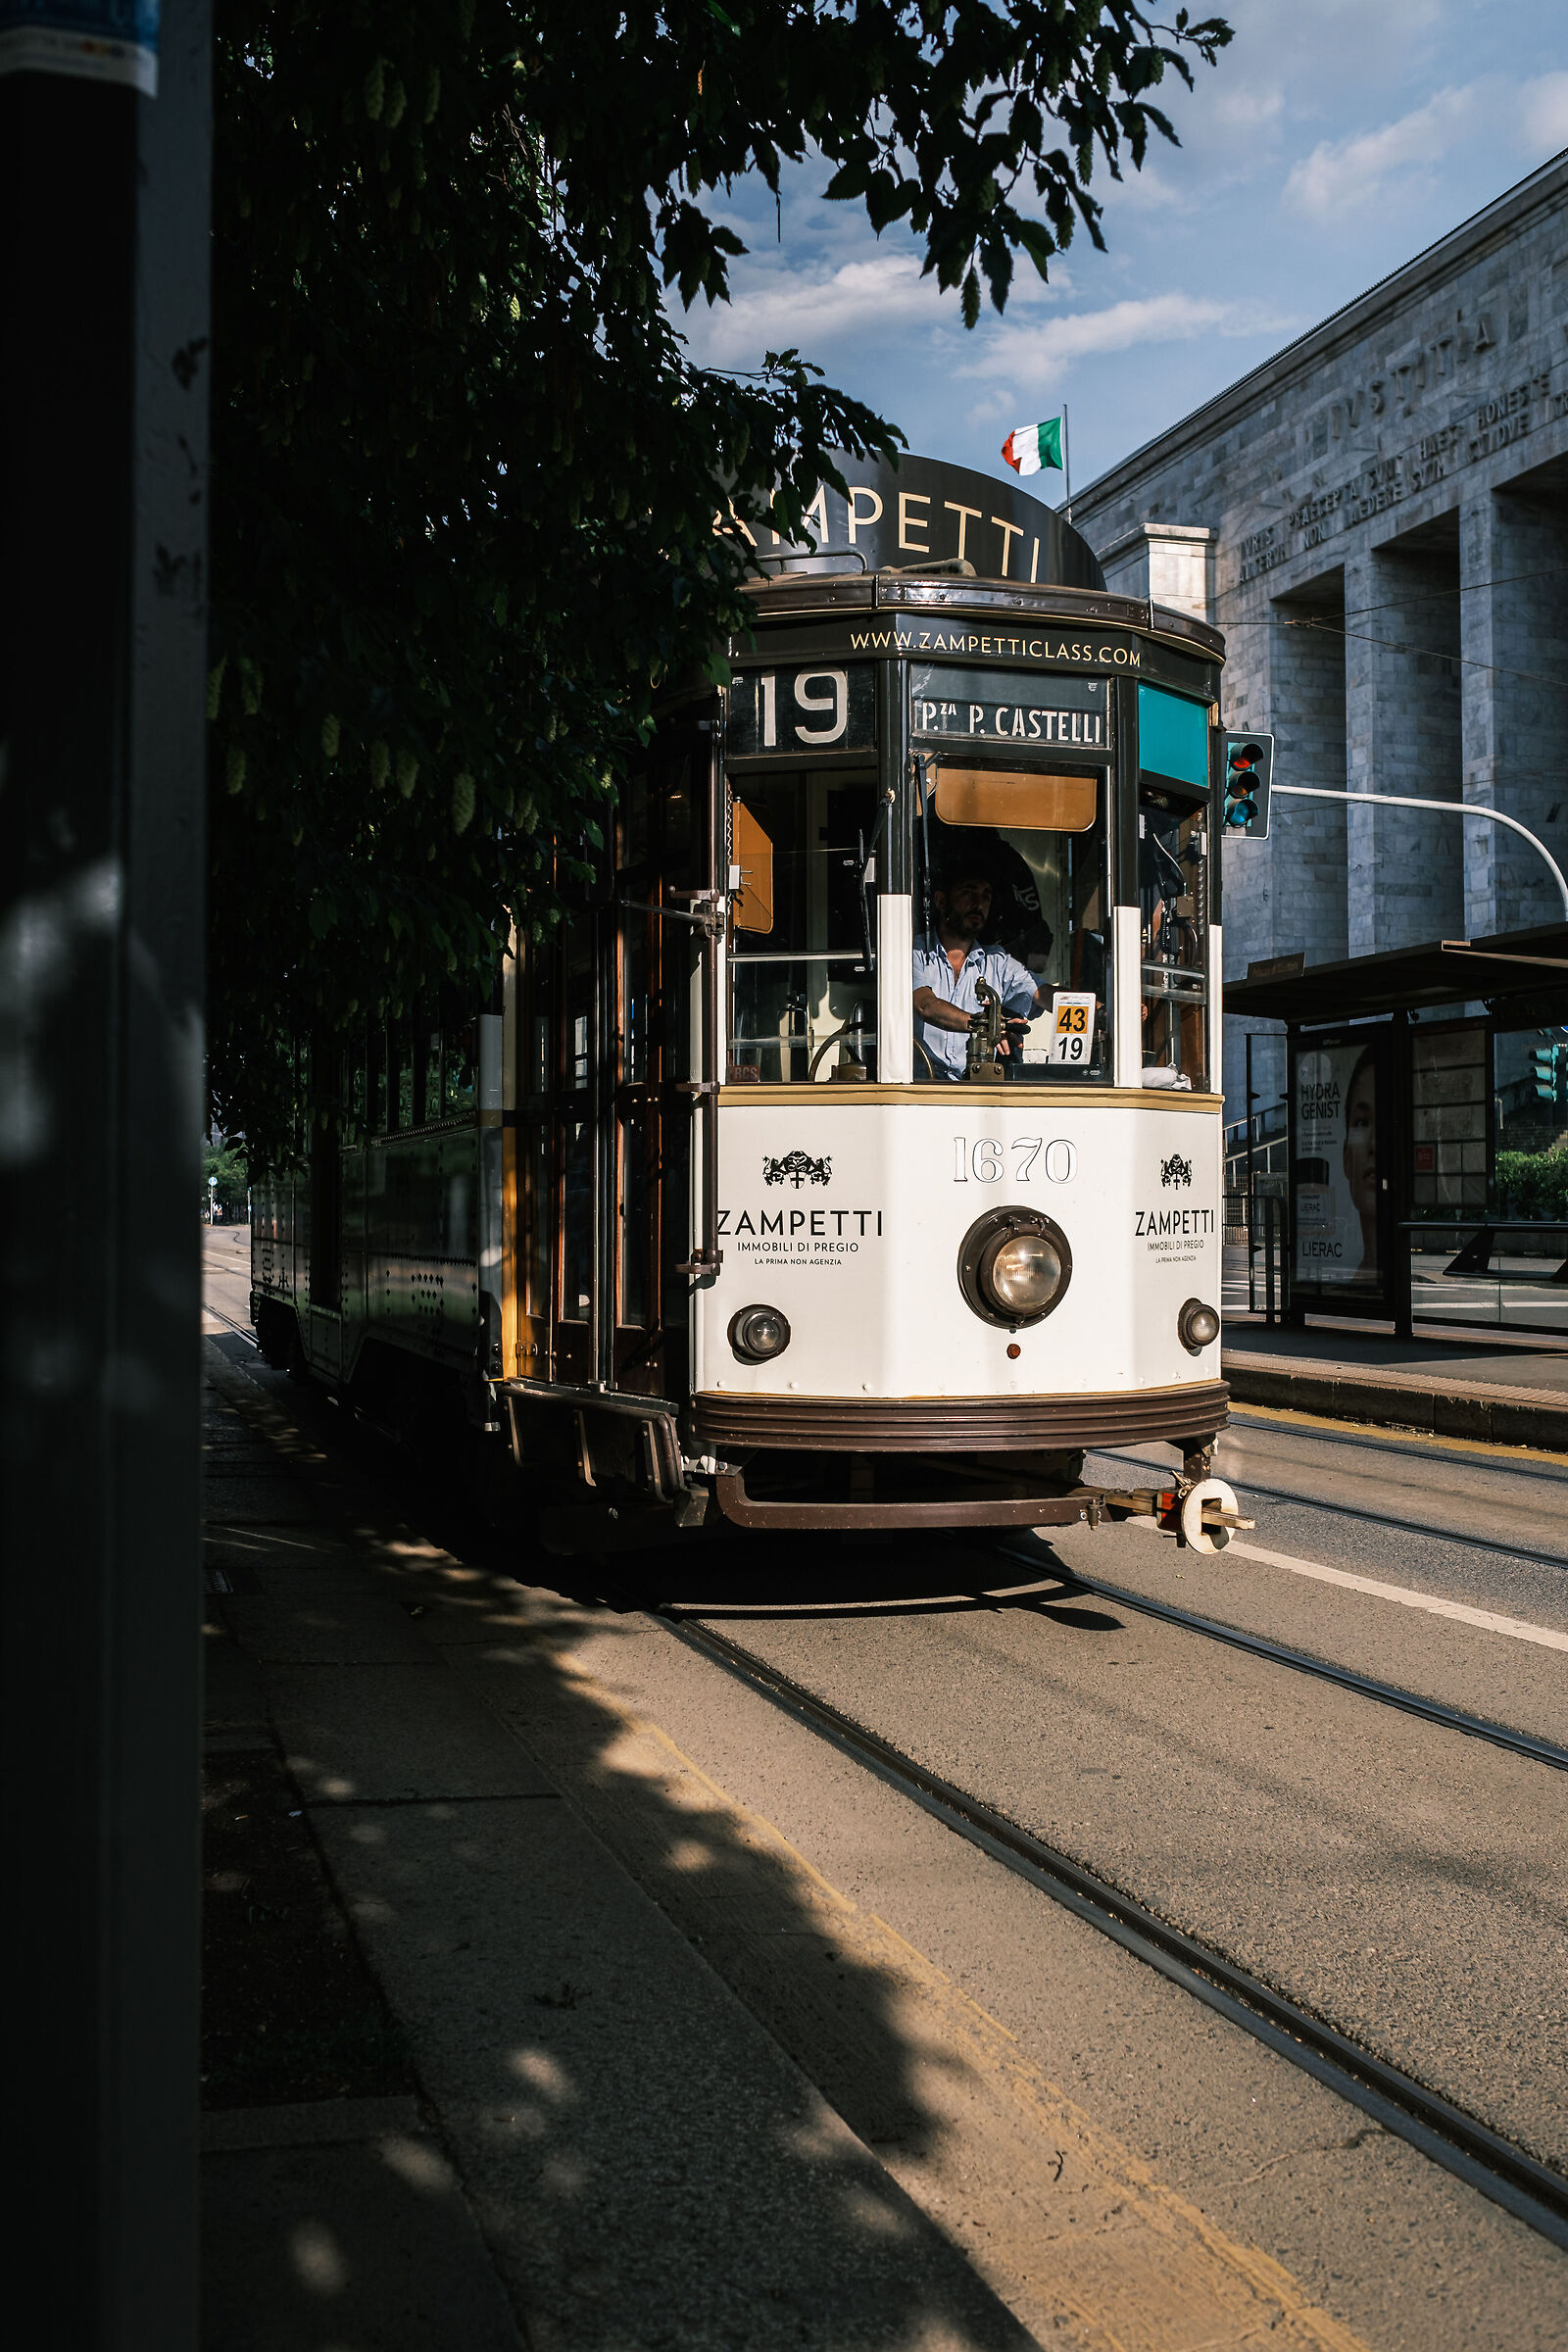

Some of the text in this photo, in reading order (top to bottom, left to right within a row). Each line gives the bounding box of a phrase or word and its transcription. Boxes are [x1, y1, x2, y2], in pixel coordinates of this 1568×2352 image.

[851, 631, 1141, 666] WWW.ZAMPETTICLASS.COM
[760, 665, 848, 747] 19
[969, 705, 985, 734] P.
[995, 707, 1101, 744] CASTELLI
[1058, 1007, 1086, 1032] 43
[1057, 1037, 1083, 1060] 19
[1301, 1081, 1341, 1102] HYDRA
[1301, 1101, 1341, 1120] GENIST
[953, 1137, 1078, 1185] 1670
[717, 1209, 882, 1237] ZAMPETTI
[1135, 1209, 1214, 1237] ZAMPETTI
[737, 1242, 858, 1252] IMMOBILI DI PREGIO
[1147, 1239, 1204, 1251] IMMOBILI DI PREGIO
[1301, 1242, 1343, 1257] LIERAC
